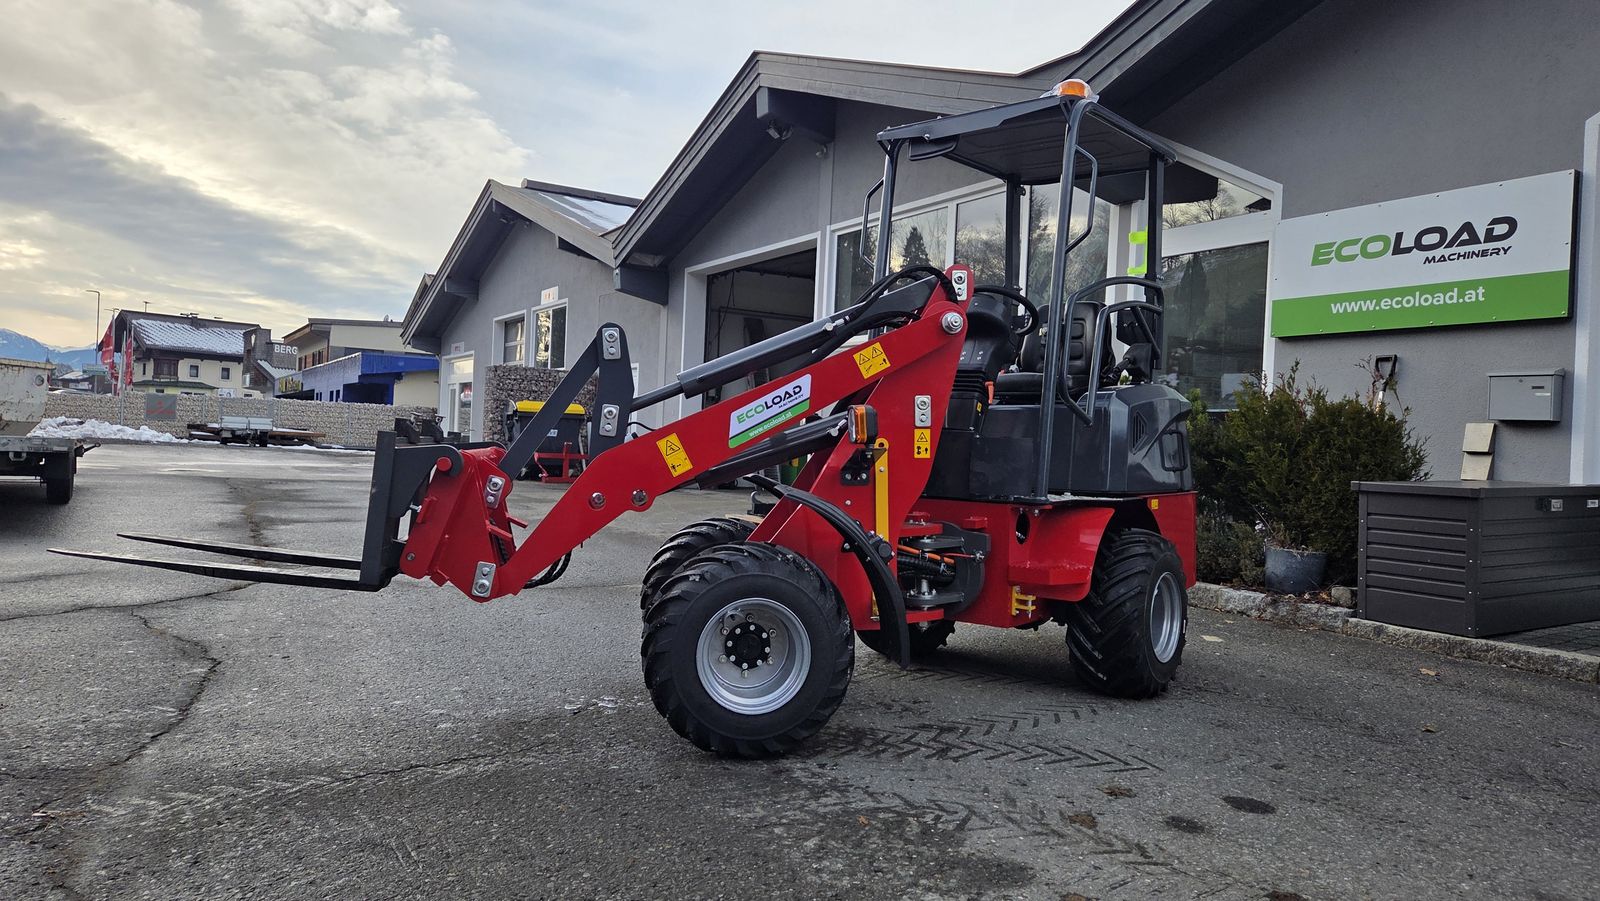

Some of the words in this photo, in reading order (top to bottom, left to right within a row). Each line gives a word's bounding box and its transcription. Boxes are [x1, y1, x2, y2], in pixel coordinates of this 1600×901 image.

[1310, 216, 1518, 267] ECOLOAD
[1423, 245, 1512, 265] MACHINERY
[1330, 285, 1486, 314] www.ecoload.at
[274, 344, 298, 355] BERG
[736, 384, 802, 424] ECOLOAD
[748, 411, 793, 437] www.ecoload.at
